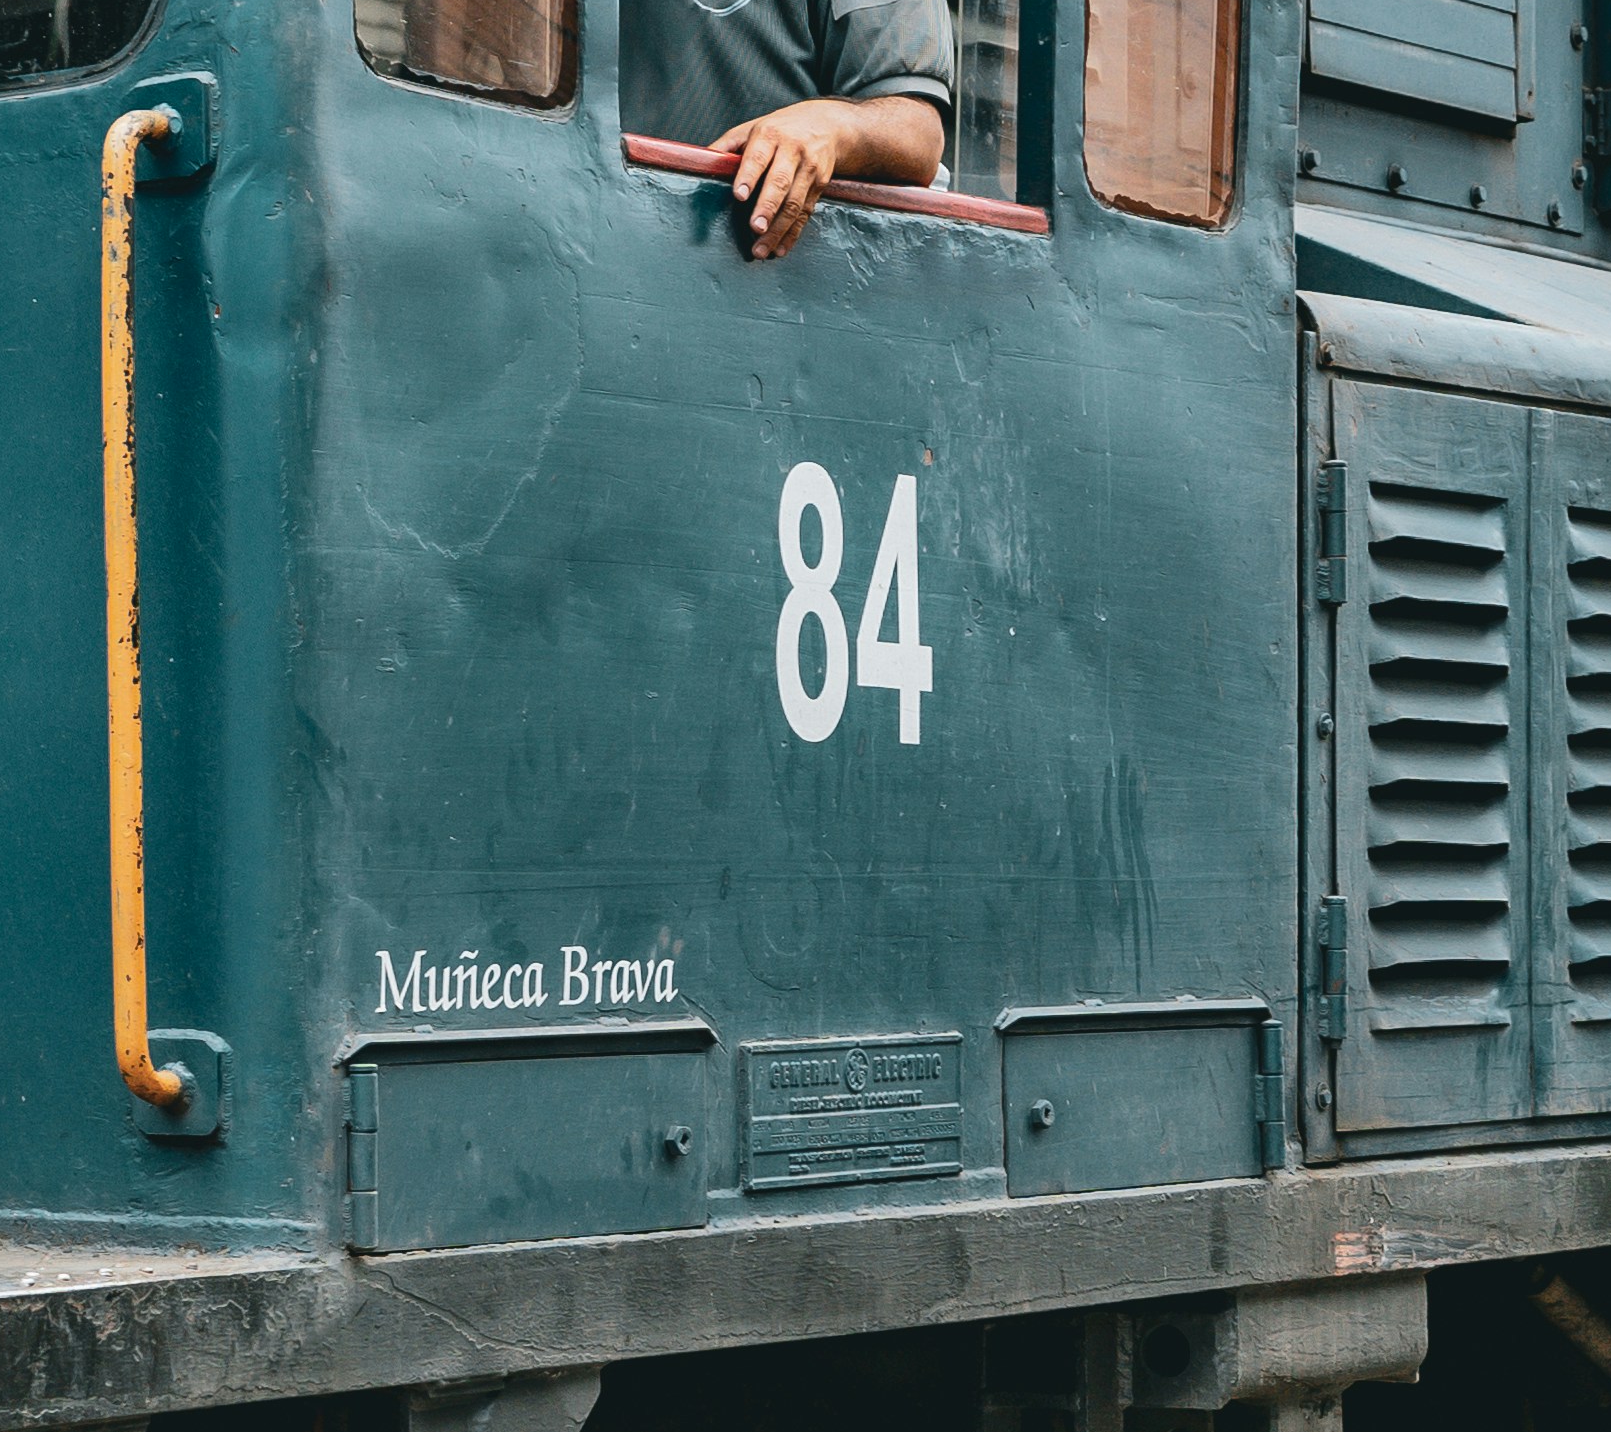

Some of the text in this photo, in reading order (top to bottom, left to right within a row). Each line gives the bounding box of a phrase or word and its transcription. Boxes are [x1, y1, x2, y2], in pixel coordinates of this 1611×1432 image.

[776, 460, 934, 745] 84
[375, 945, 679, 1013] Muñeca Brava
[770, 1059, 840, 1089] GENERAL
[873, 1052, 942, 1082] ELECTRIC
